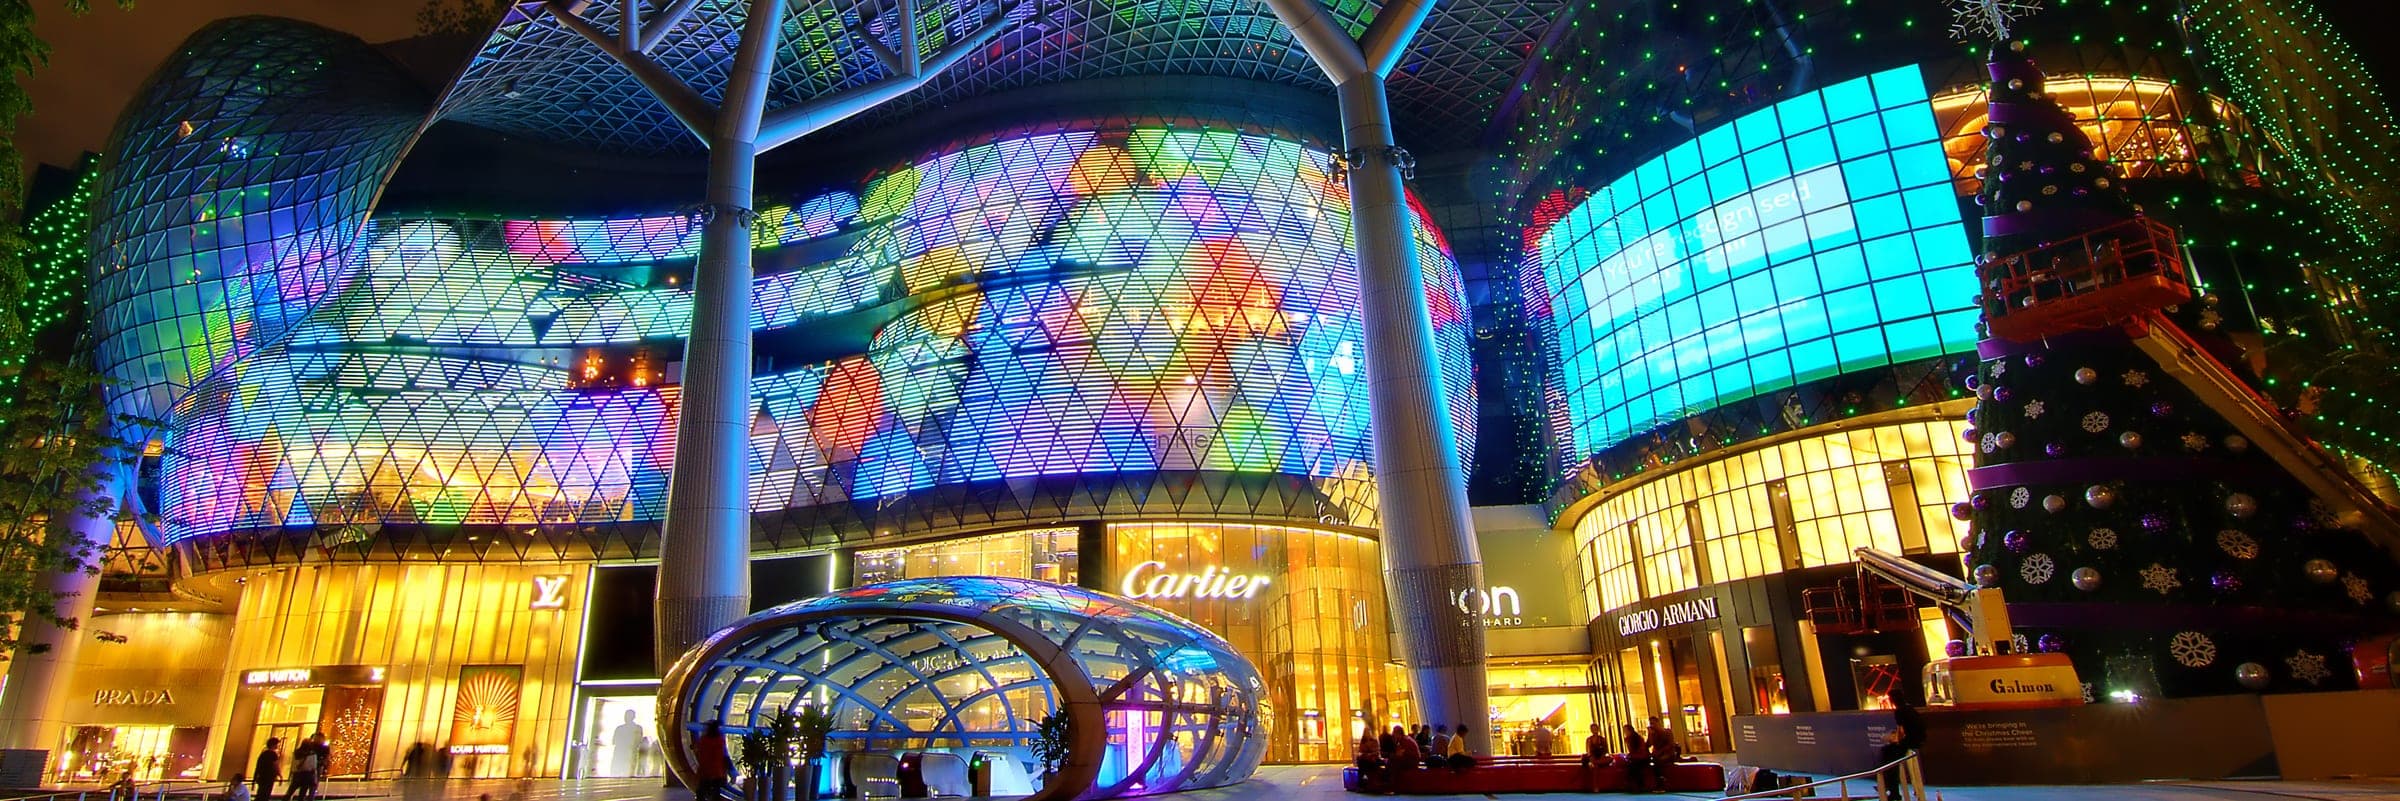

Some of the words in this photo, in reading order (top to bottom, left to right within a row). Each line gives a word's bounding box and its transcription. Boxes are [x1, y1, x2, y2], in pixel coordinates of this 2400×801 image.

[1121, 560, 1271, 600] Cartier
[1618, 608, 1659, 637] GIORGIO
[1663, 597, 1716, 627] ARMANI
[270, 668, 311, 683] VUITTON
[1989, 679, 2055, 694] Galmon
[93, 688, 176, 705] PRADA
